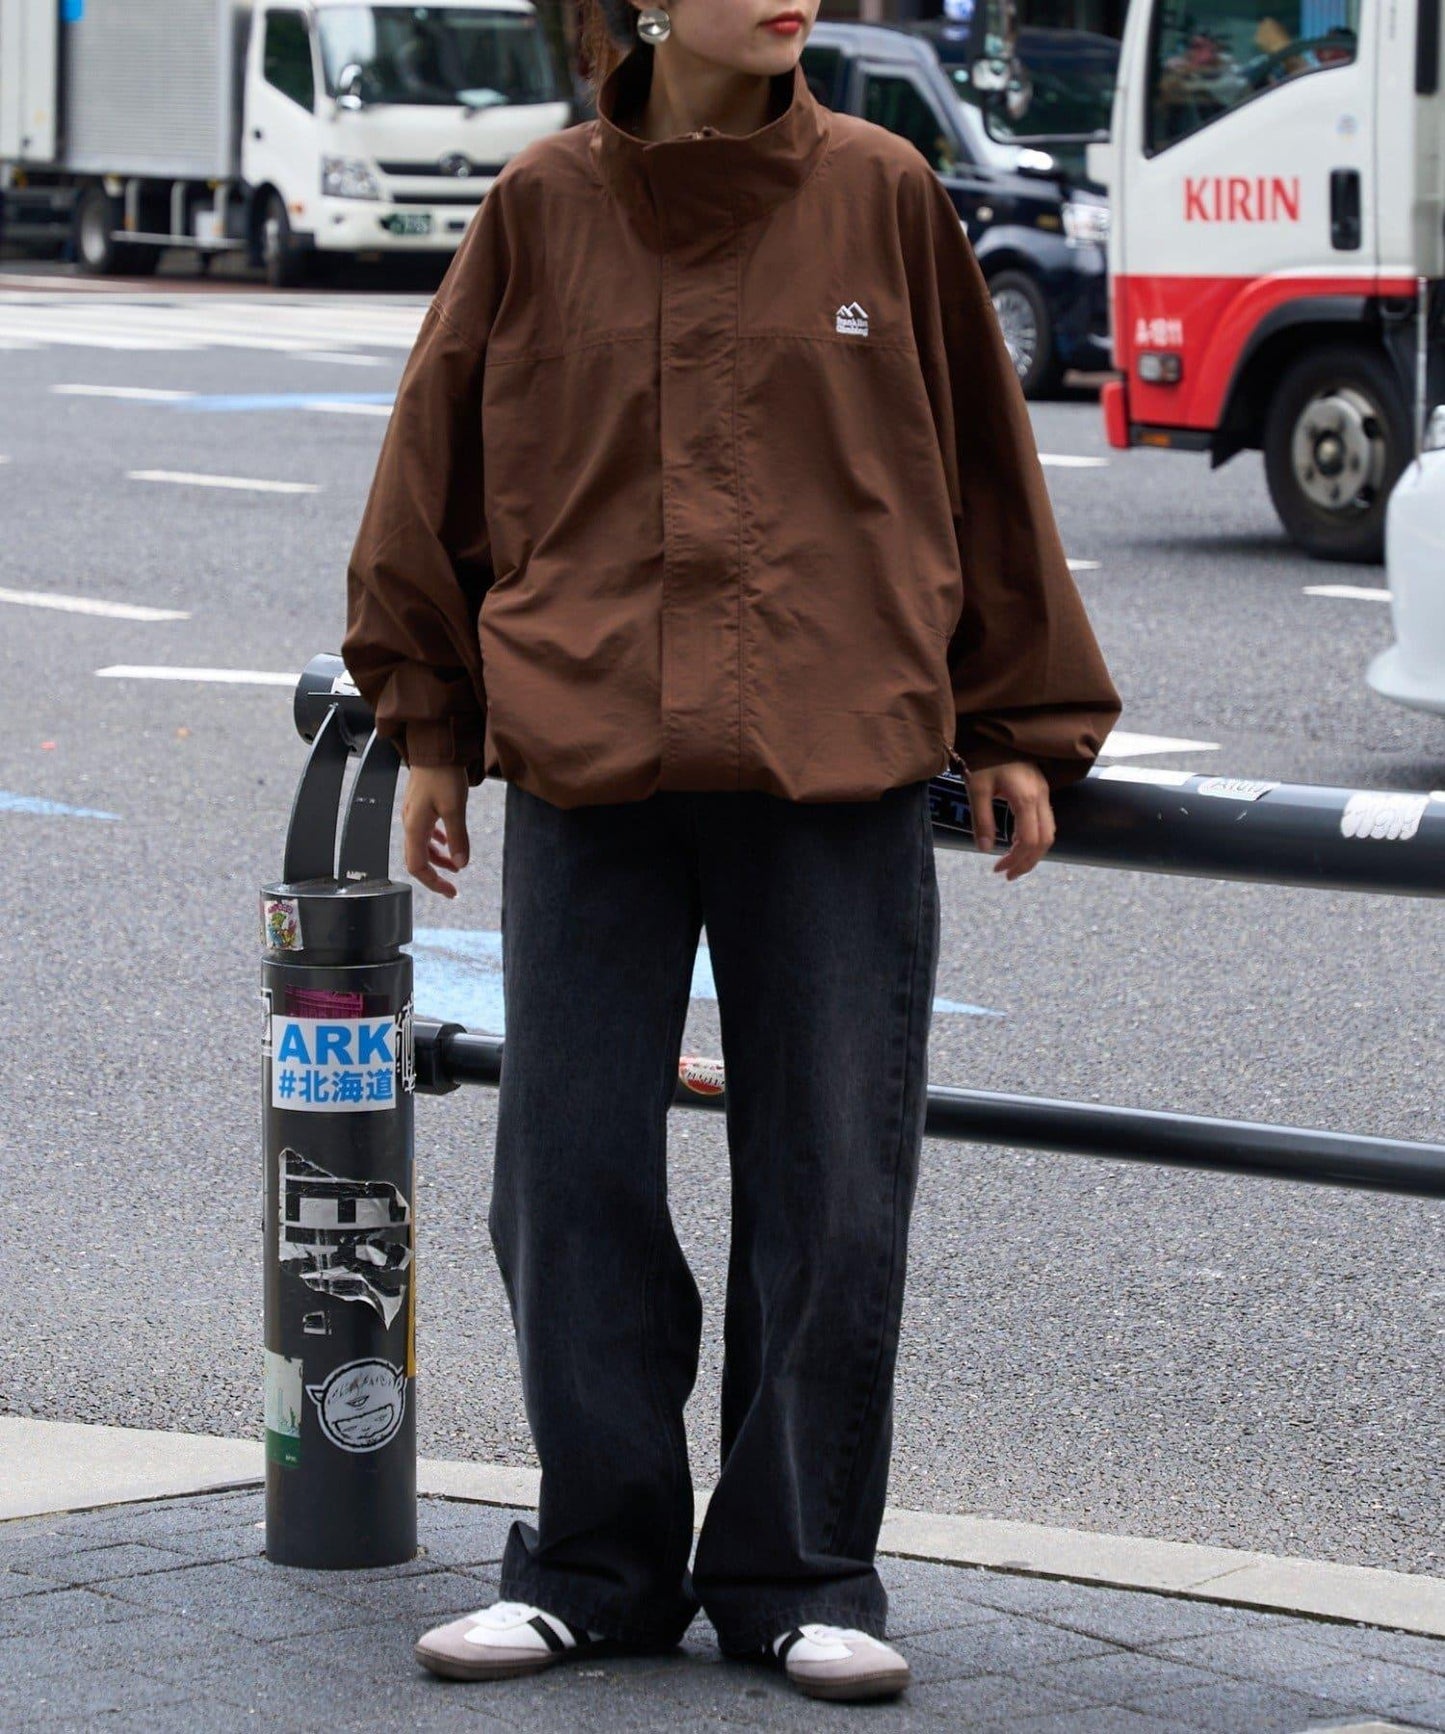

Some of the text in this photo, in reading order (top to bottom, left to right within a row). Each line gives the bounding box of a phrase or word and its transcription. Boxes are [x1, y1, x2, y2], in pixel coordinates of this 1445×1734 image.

[1184, 177, 1300, 221] KIRIN
[279, 1023, 394, 1065] ARK
[280, 1069, 393, 1103] #北海道
